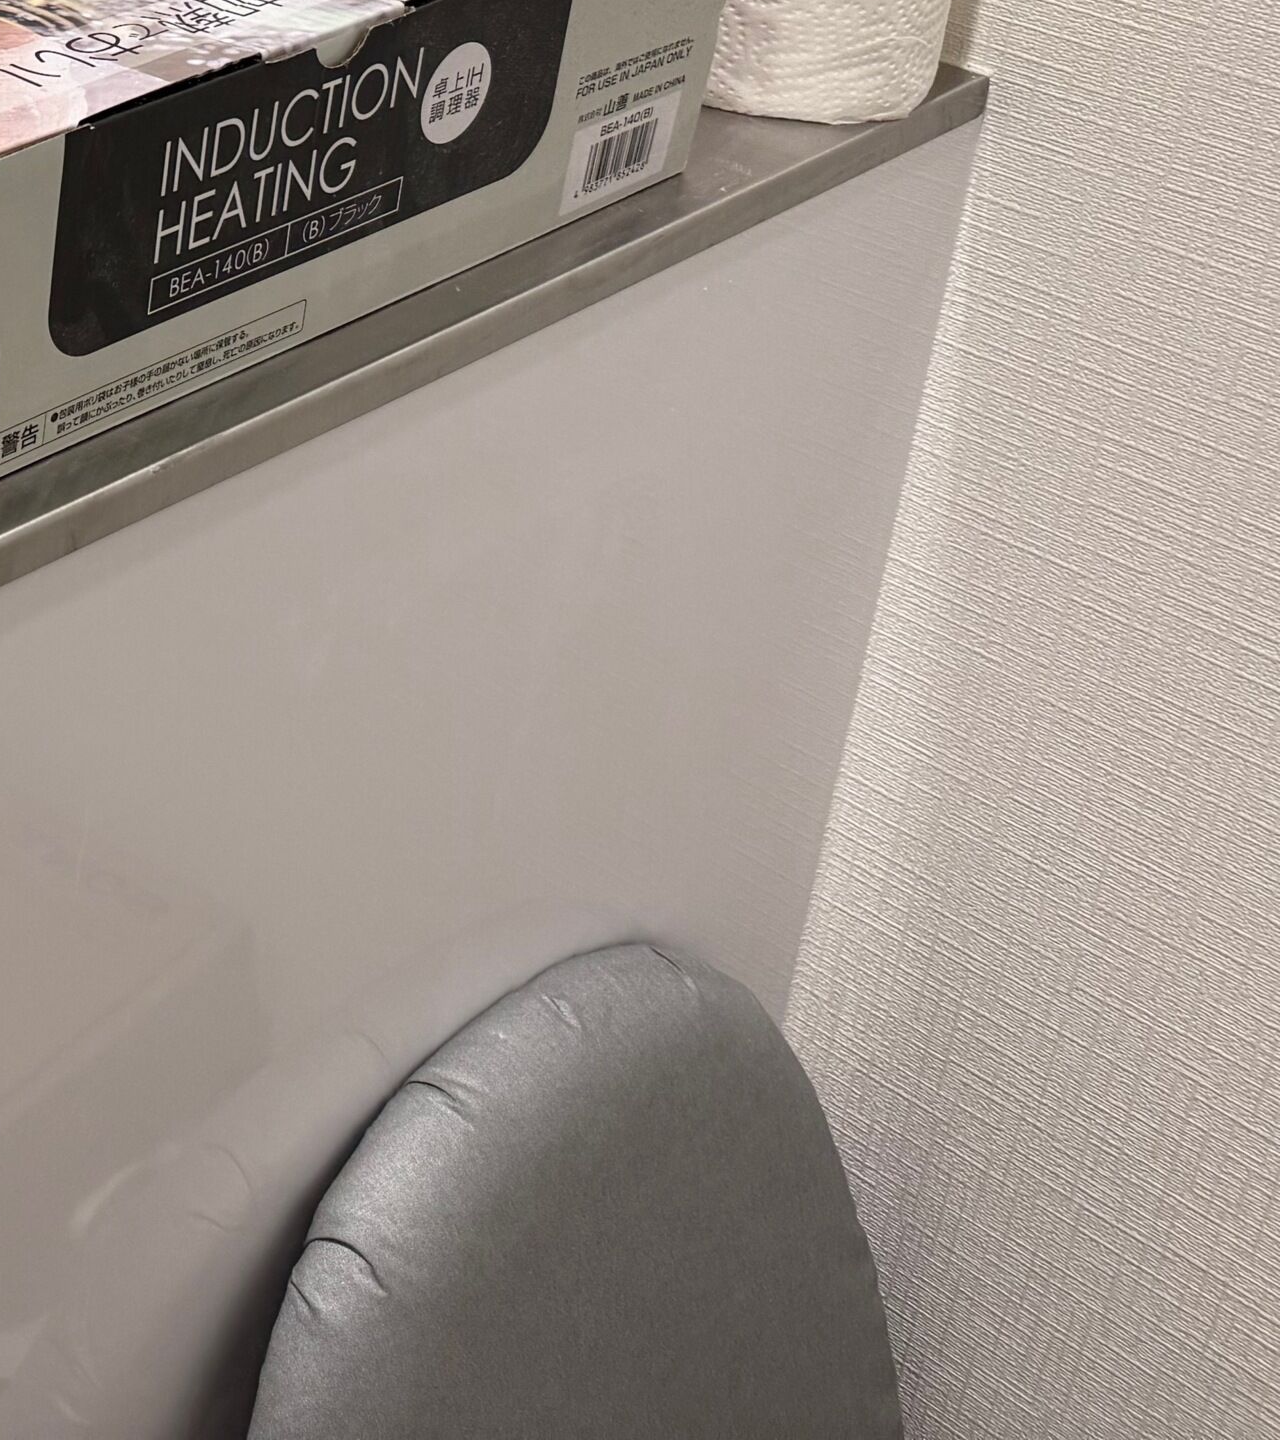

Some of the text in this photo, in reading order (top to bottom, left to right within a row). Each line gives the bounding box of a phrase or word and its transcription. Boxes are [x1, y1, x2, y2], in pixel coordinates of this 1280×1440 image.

[431, 62, 485, 102] 卓上IH
[576, 45, 693, 100] FOR USE IN JAPAN ONLY
[427, 85, 482, 125] 調理器
[602, 92, 631, 117] 山善
[632, 86, 654, 102] MADE
[654, 84, 662, 94] IN
[663, 74, 686, 90] CHINA
[158, 45, 426, 198] INDUCTION
[600, 106, 654, 137] BEA-140(B)
[152, 130, 361, 265] HEATING
[167, 237, 271, 300] BEA-140(B)
[326, 191, 382, 233] ブラック
[0, 419, 40, 460] 警告
